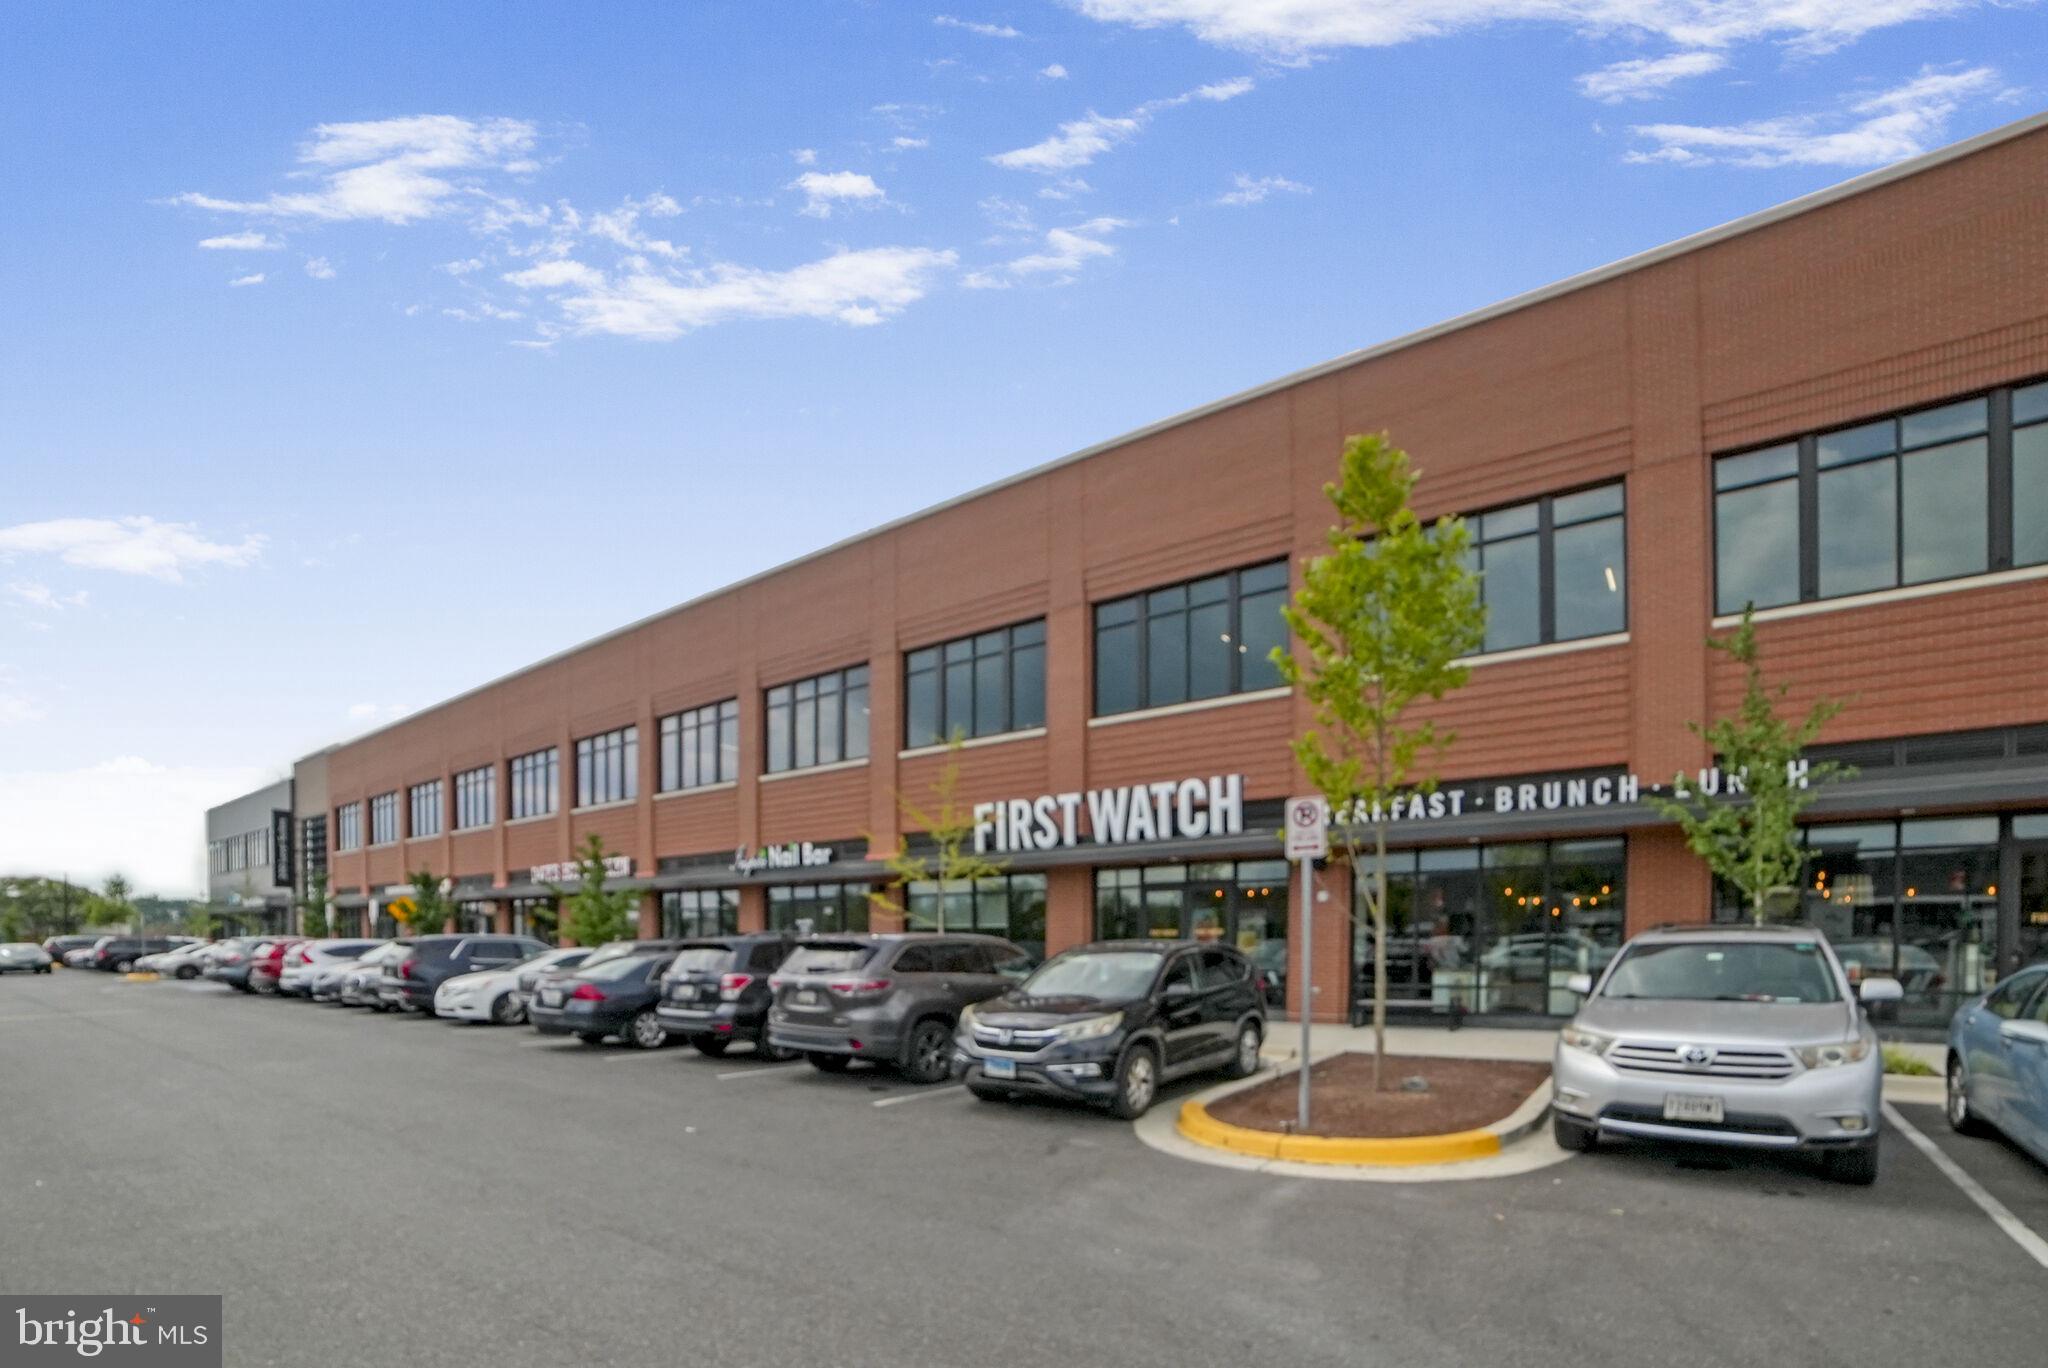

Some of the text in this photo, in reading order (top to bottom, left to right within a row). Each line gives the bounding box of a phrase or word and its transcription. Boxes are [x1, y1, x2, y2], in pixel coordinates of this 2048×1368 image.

[1494, 774, 1639, 812] BRUNCH
[1675, 759, 1809, 799] LUNH
[973, 774, 1243, 854] FIRST WATCH
[768, 841, 800, 869] Nail
[801, 842, 833, 867] Bar
